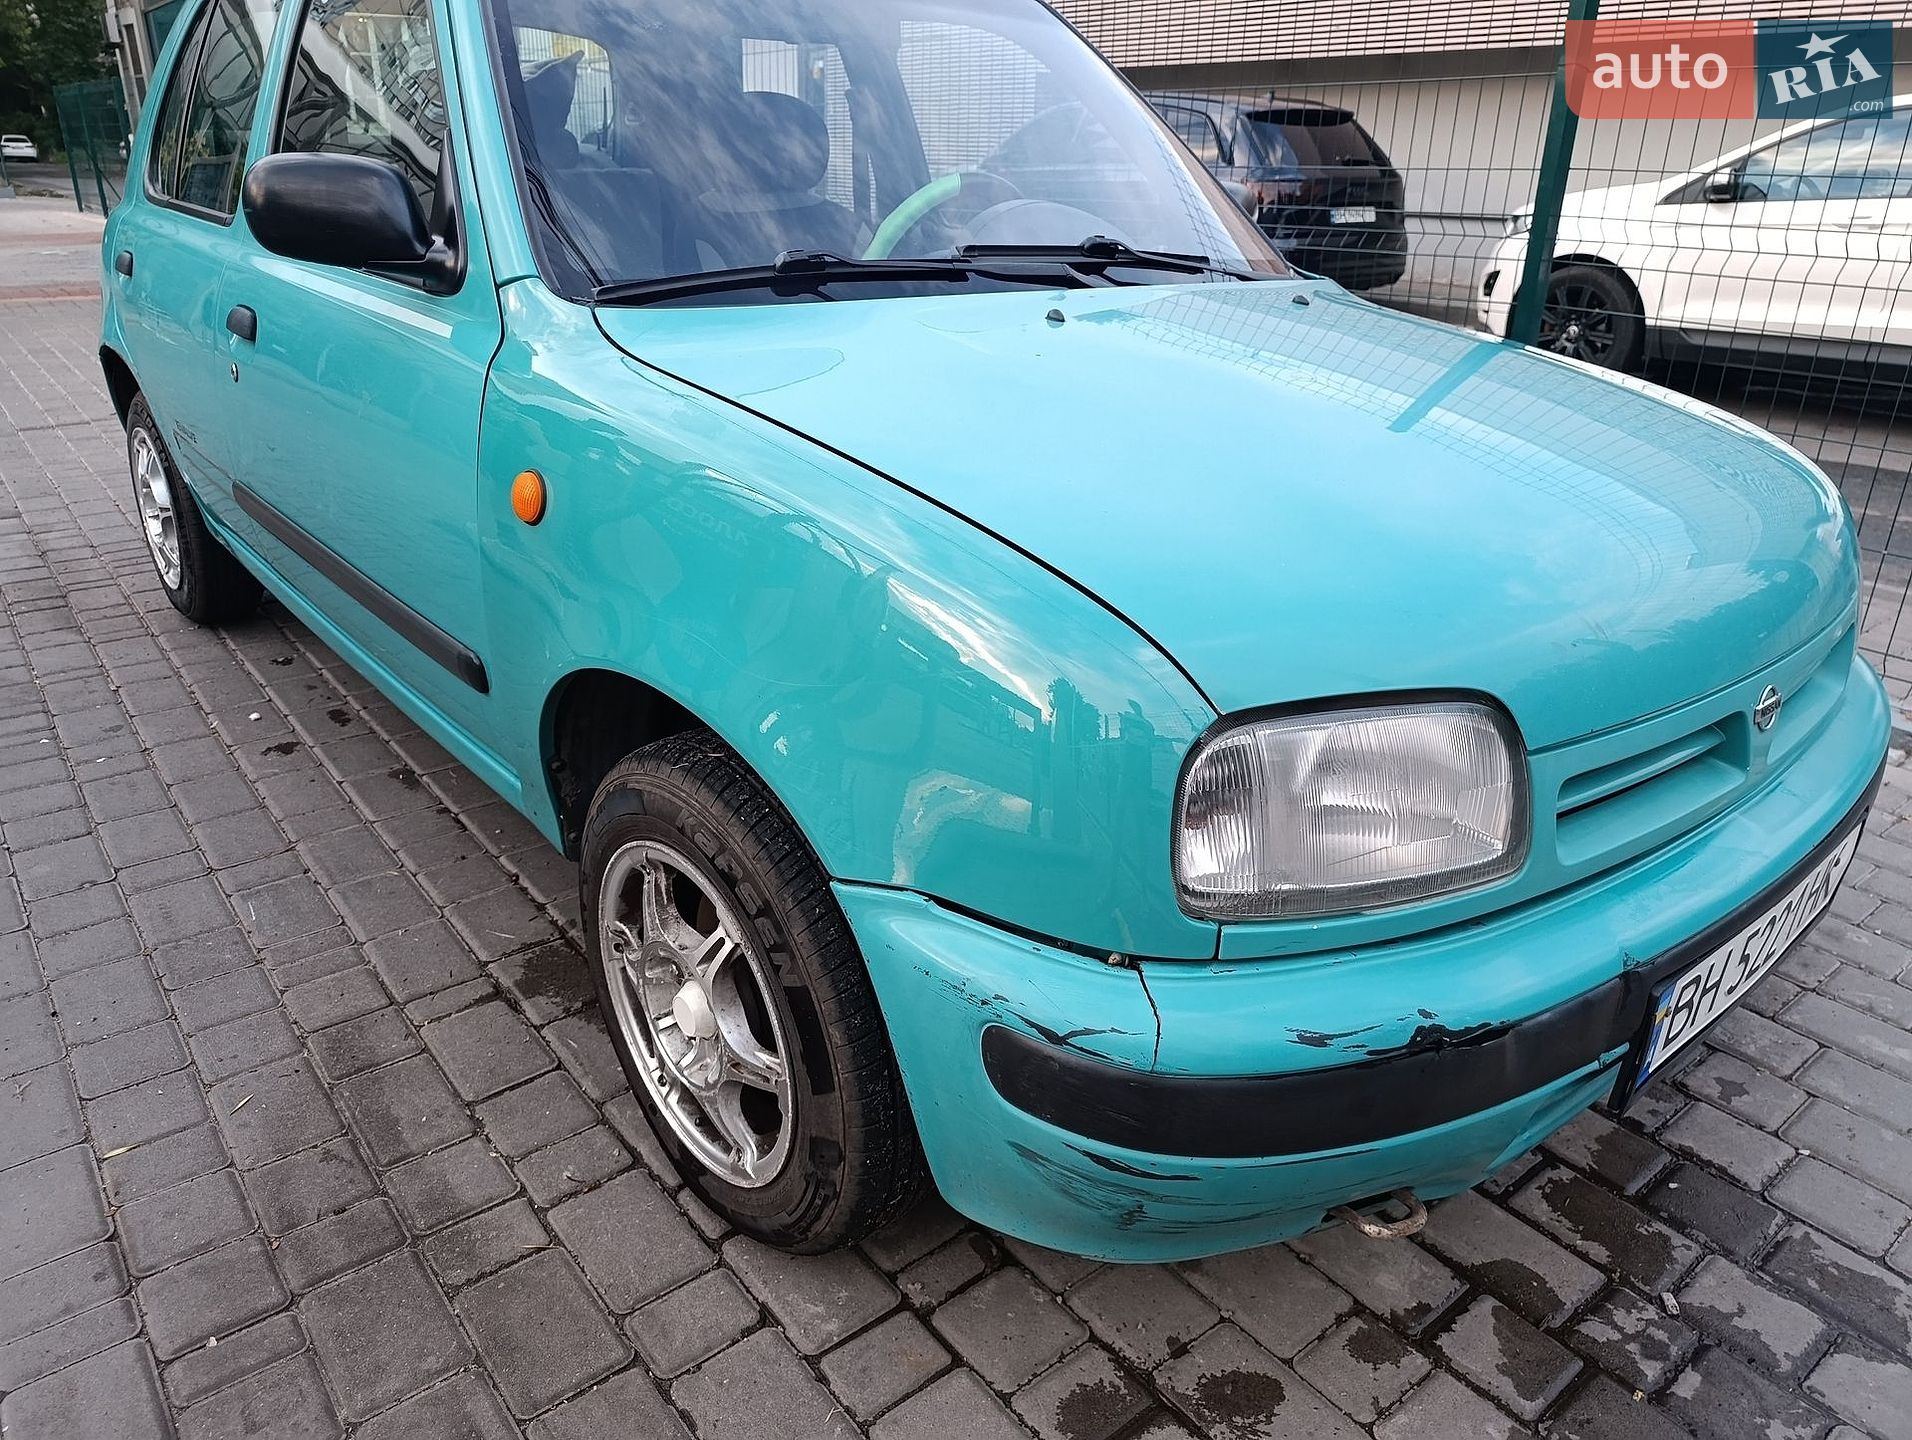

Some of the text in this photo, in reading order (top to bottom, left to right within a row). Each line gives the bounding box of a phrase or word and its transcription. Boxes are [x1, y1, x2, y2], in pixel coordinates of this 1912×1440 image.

[1661, 841, 1848, 1051] BH 5221 HK
